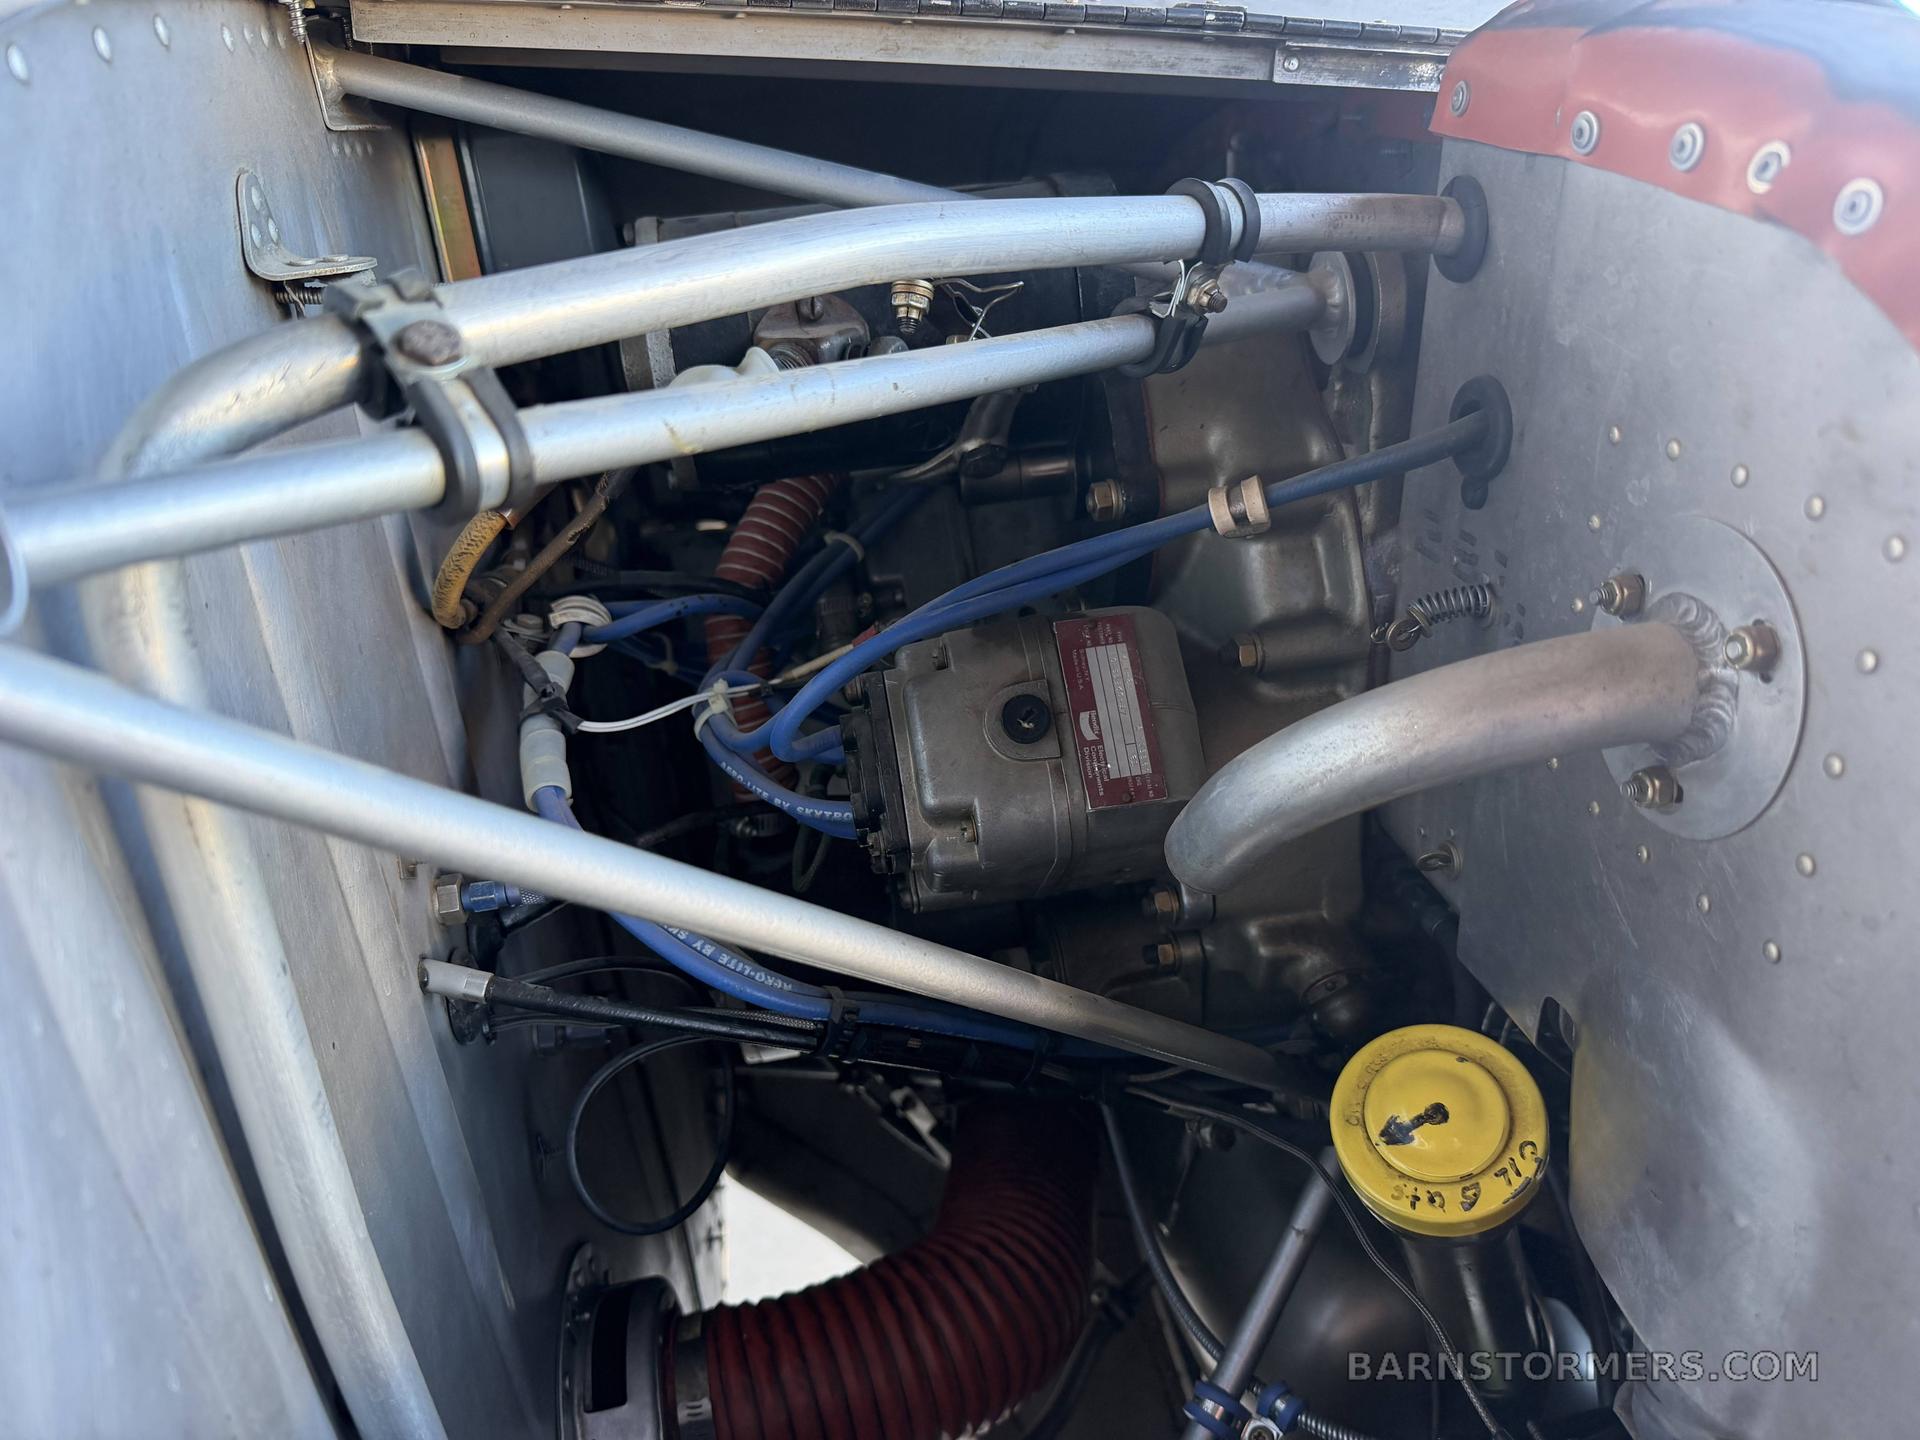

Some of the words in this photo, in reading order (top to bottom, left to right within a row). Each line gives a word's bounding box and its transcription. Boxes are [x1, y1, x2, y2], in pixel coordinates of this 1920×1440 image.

[1083, 747, 1093, 778] Division
[774, 797, 790, 810] BY
[692, 939, 716, 957] BY
